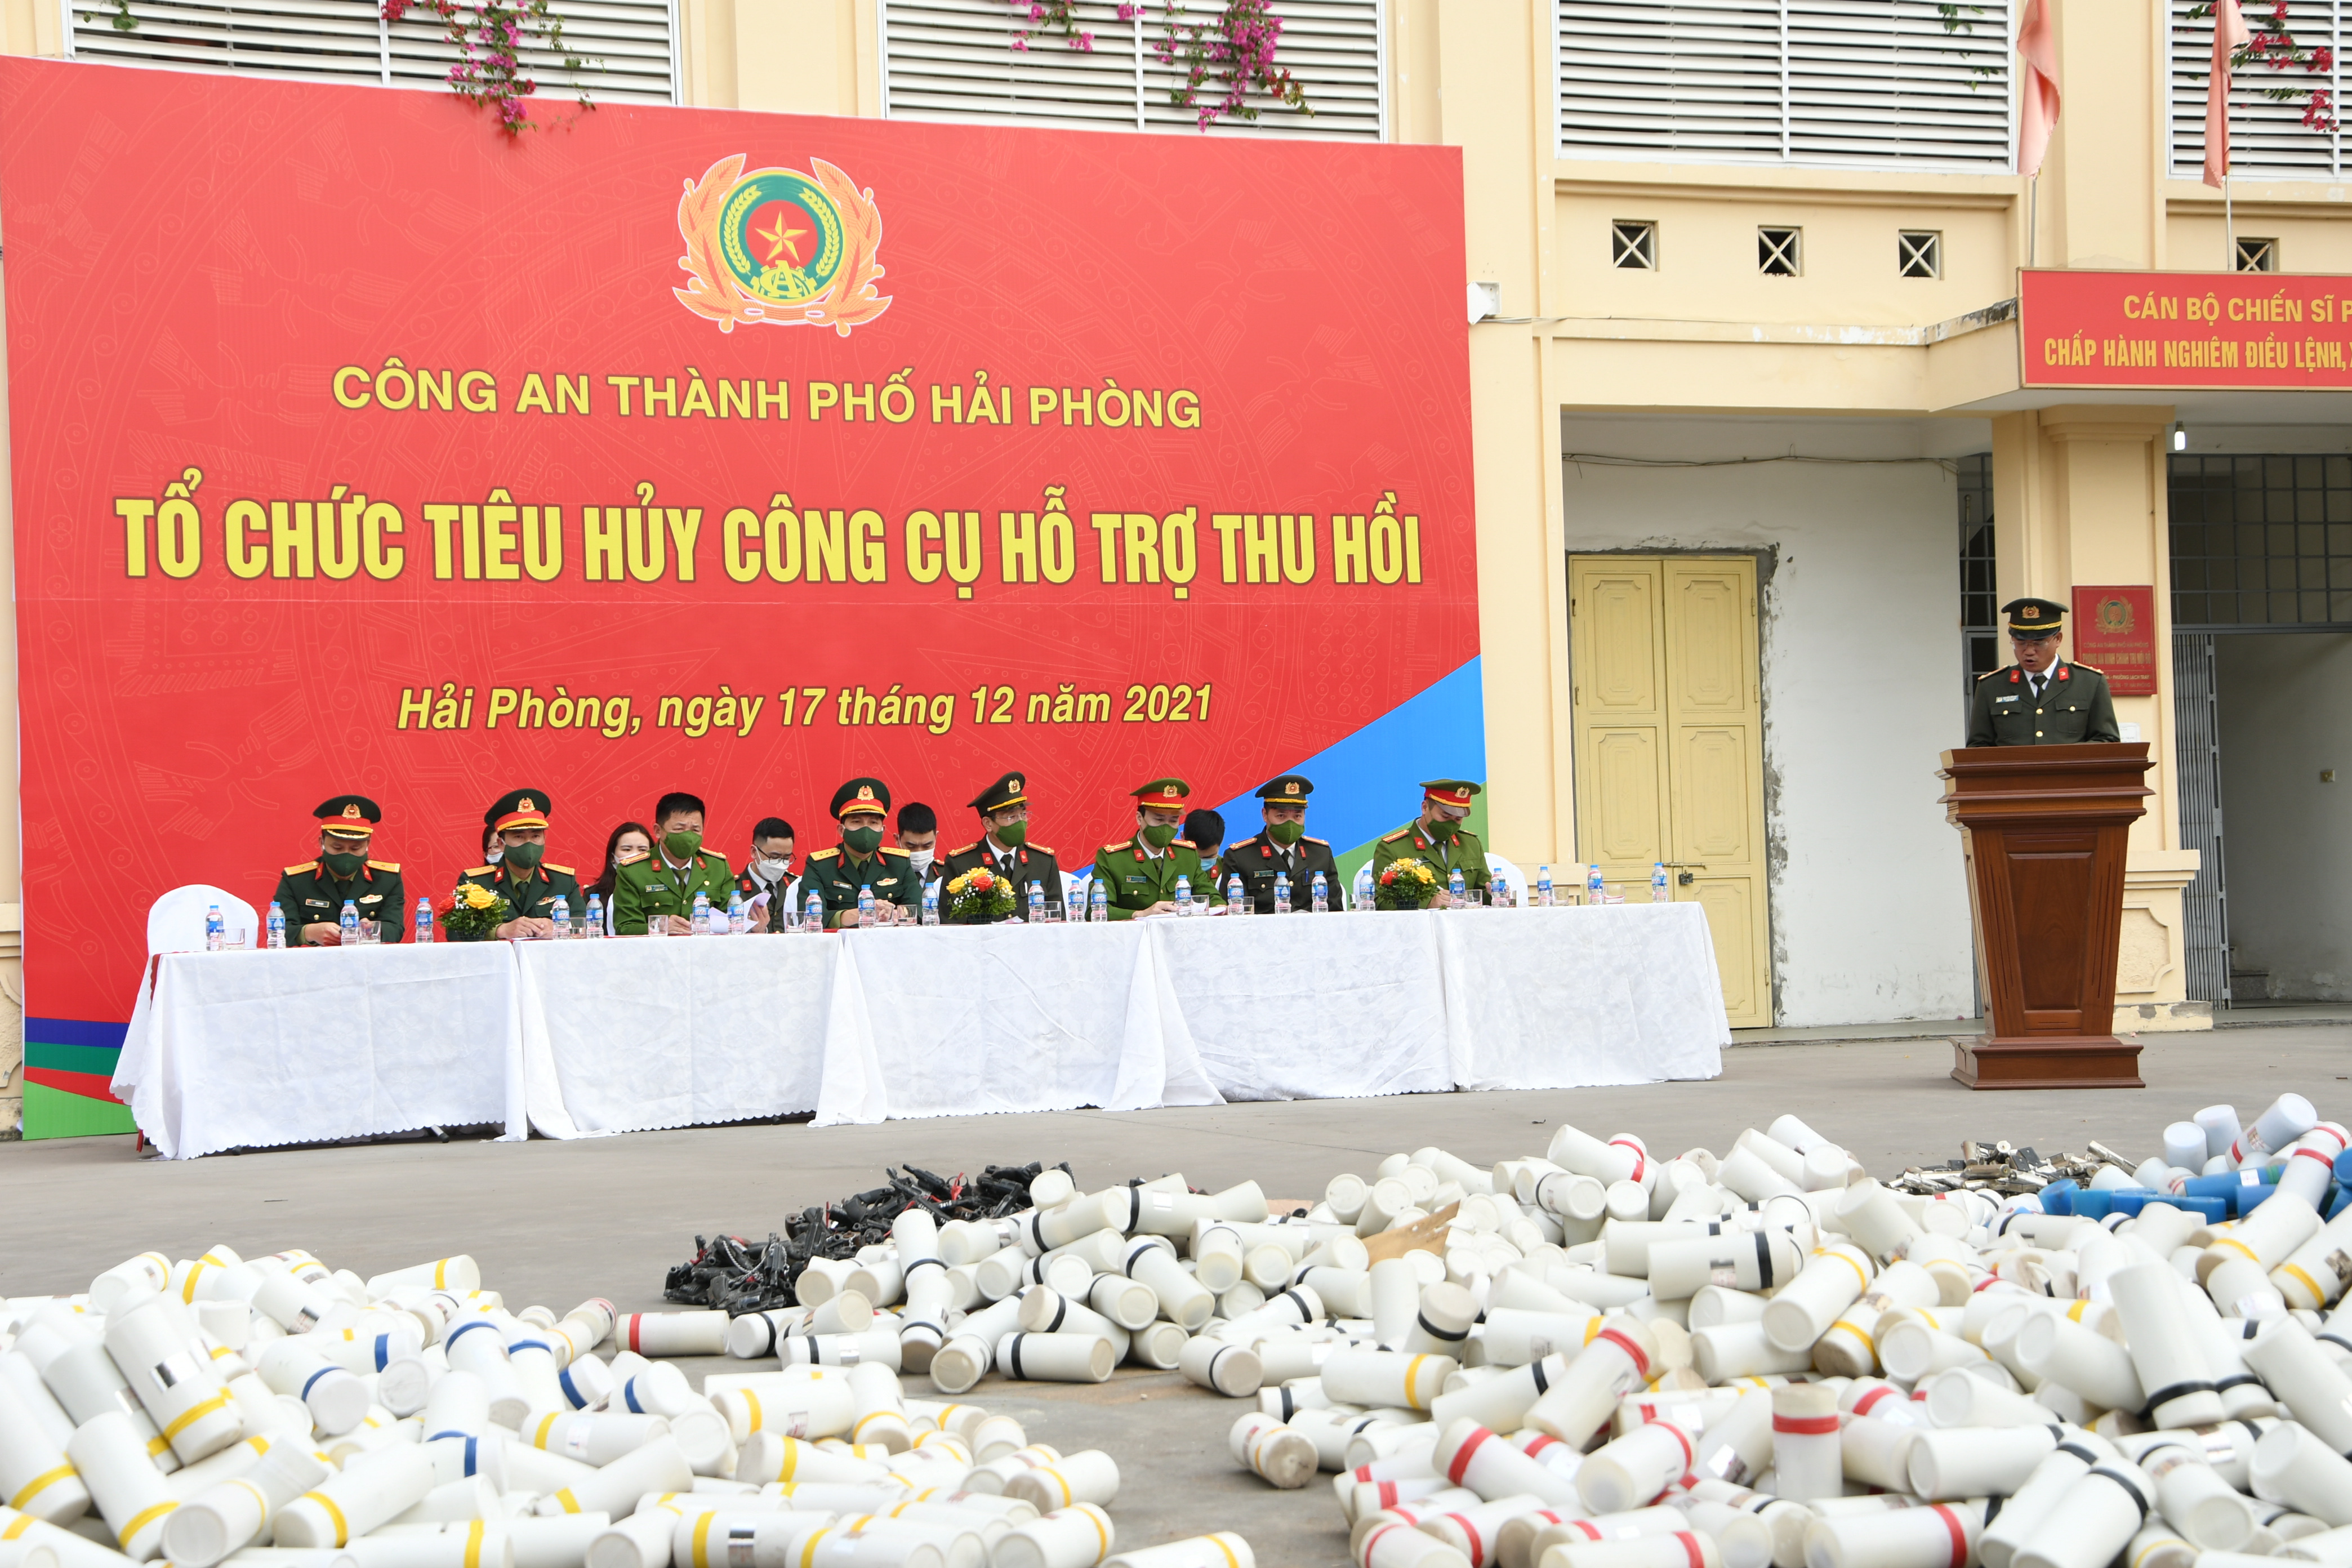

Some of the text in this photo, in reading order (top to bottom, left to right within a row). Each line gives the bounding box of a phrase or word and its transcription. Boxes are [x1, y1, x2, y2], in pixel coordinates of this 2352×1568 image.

[2123, 291, 2178, 320] CÁN
[2186, 292, 2220, 326] BỘ
[2228, 288, 2302, 322] CHIẾN
[2310, 295, 2335, 323] SĨ
[2044, 329, 2097, 366] CHẤP
[2103, 335, 2157, 367] HÀNH
[2164, 336, 2238, 368] NGHIÊM
[2245, 332, 2288, 368] ĐIỀU
[2294, 336, 2346, 372] LỆNH,
[332, 356, 1201, 429] CÔNG AN THÀNH PHỐ HẢI PHÒNG
[114, 466, 1423, 600] TỔ CHỨC TIÊU HỦY CÔNG CỤ HỖ TRỢ THU HỒI
[396, 681, 1212, 739] Hải Phòng, ngày 17 tháng 12 năm 2021
